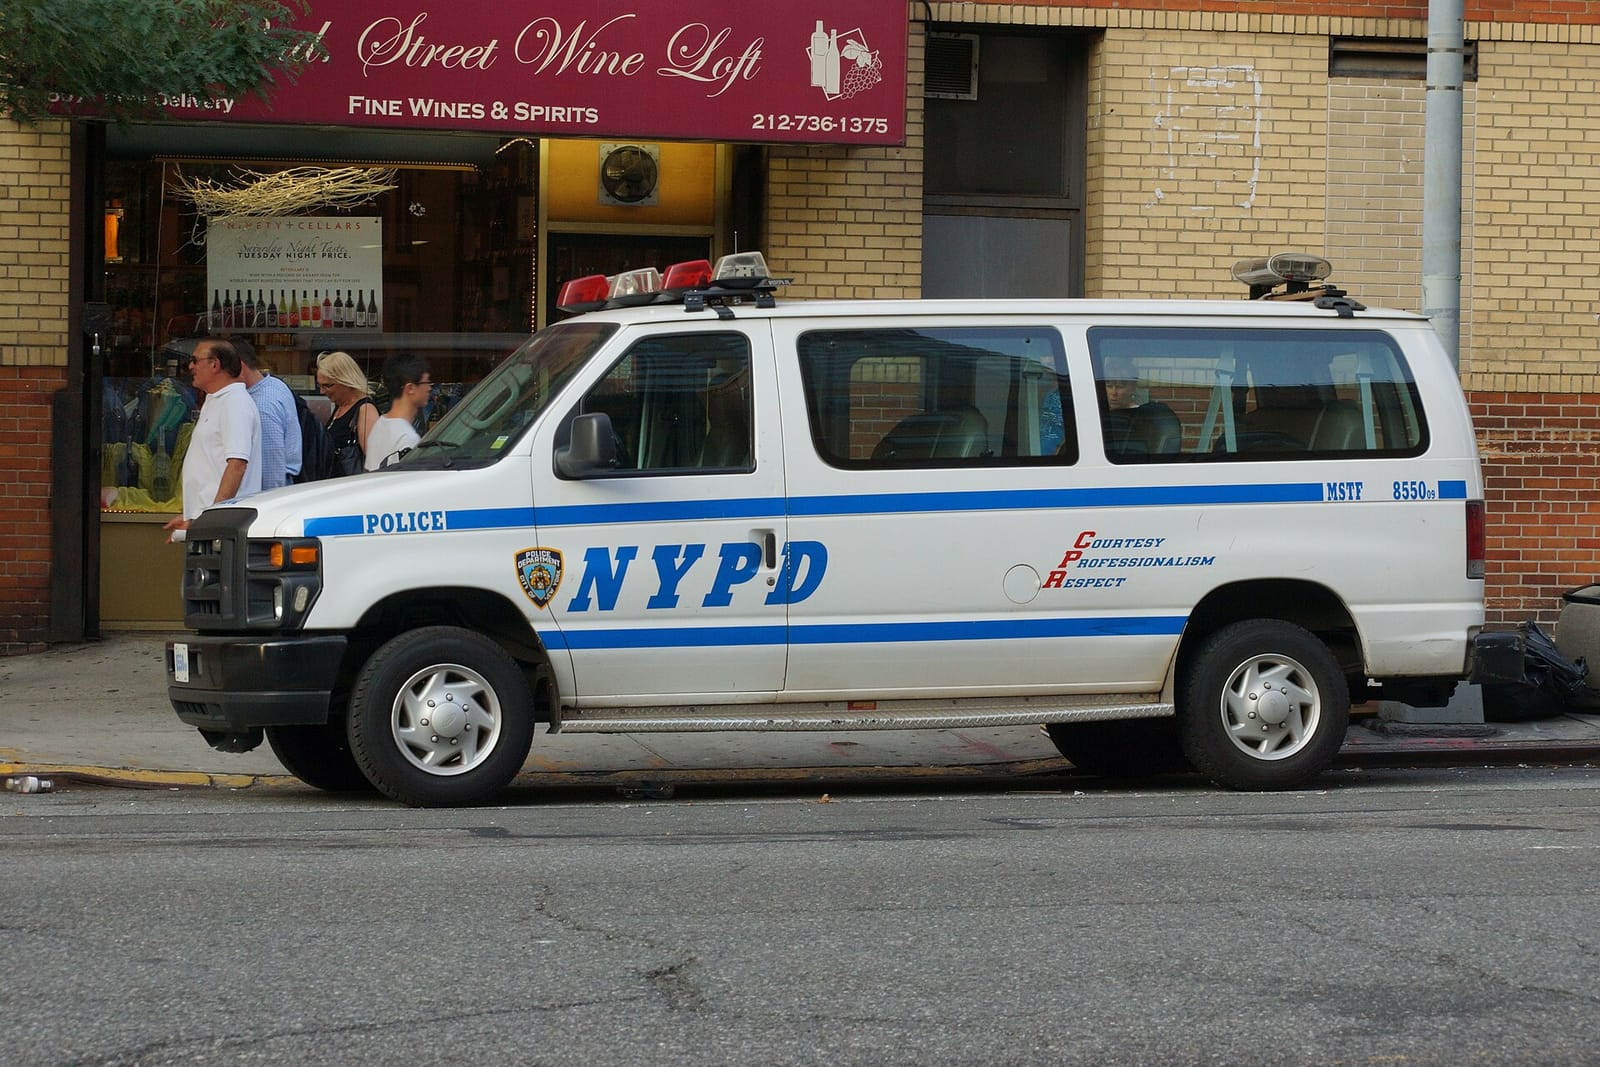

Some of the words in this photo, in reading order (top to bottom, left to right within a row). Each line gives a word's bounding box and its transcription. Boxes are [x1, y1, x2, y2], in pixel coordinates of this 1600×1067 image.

[357, 12, 499, 77] Street
[514, 13, 645, 76] Wine
[656, 22, 765, 98] Loft
[154, 91, 235, 113] Delivery
[348, 95, 403, 117] FINE
[407, 97, 486, 119] WINES
[490, 100, 508, 120] &
[513, 101, 599, 124] SPIRITS
[751, 113, 889, 134] 212-736-1375
[1326, 481, 1363, 501] MSTF
[1393, 480, 1427, 500] 8550
[365, 511, 444, 534] POLICE
[1073, 531, 1165, 549] COURTESY
[518, 556, 560, 568] DEPARTMENT
[525, 550, 552, 558] POLICE
[1058, 550, 1216, 569] PROFESSIONALISM
[566, 540, 828, 613] NYPD
[1042, 570, 1126, 589] RESPECT
